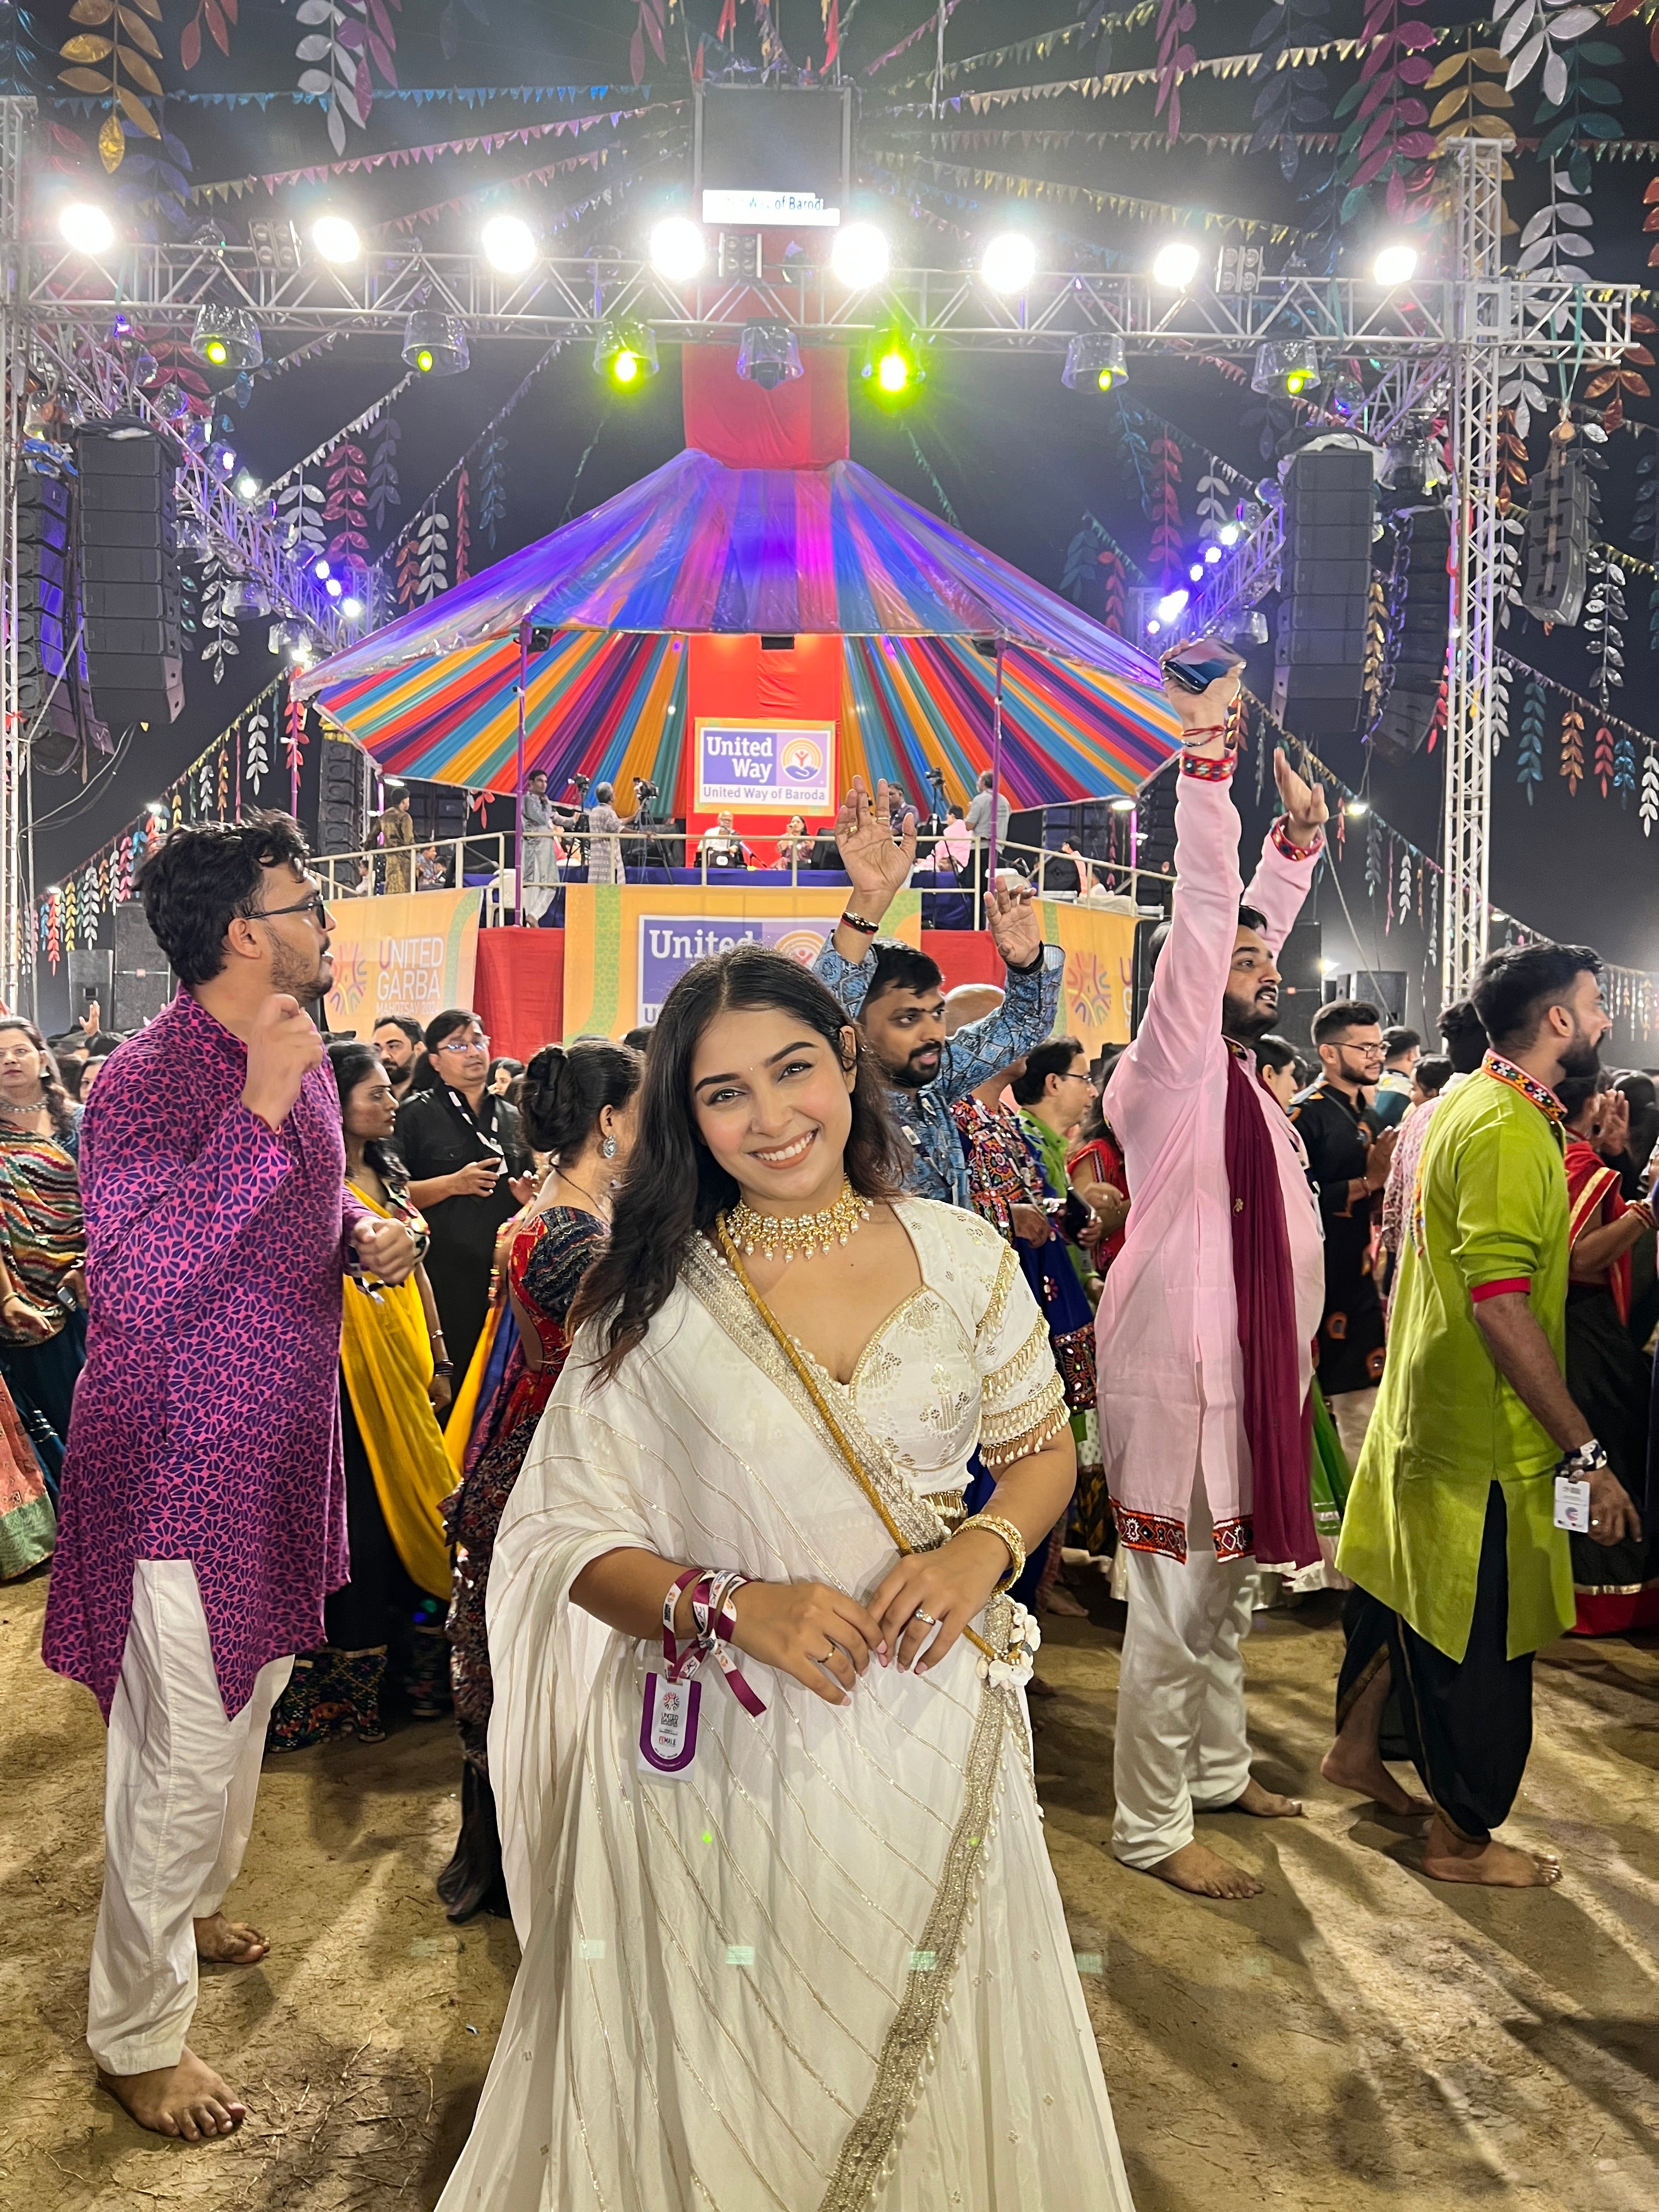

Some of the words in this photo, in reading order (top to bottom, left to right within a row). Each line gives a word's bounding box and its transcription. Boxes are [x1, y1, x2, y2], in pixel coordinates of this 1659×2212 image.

[775, 195, 785, 210] of
[706, 736, 774, 757] United
[732, 758, 772, 783] Way
[703, 787, 741, 798] United
[744, 787, 768, 801] Way
[771, 788, 783, 799] of
[786, 789, 825, 800] Baroda
[380, 936, 444, 969] UNITED
[378, 970, 441, 1001] GARBA
[376, 1002, 420, 1014] MAHOTSAV
[659, 1736, 676, 1745] FEMALE
